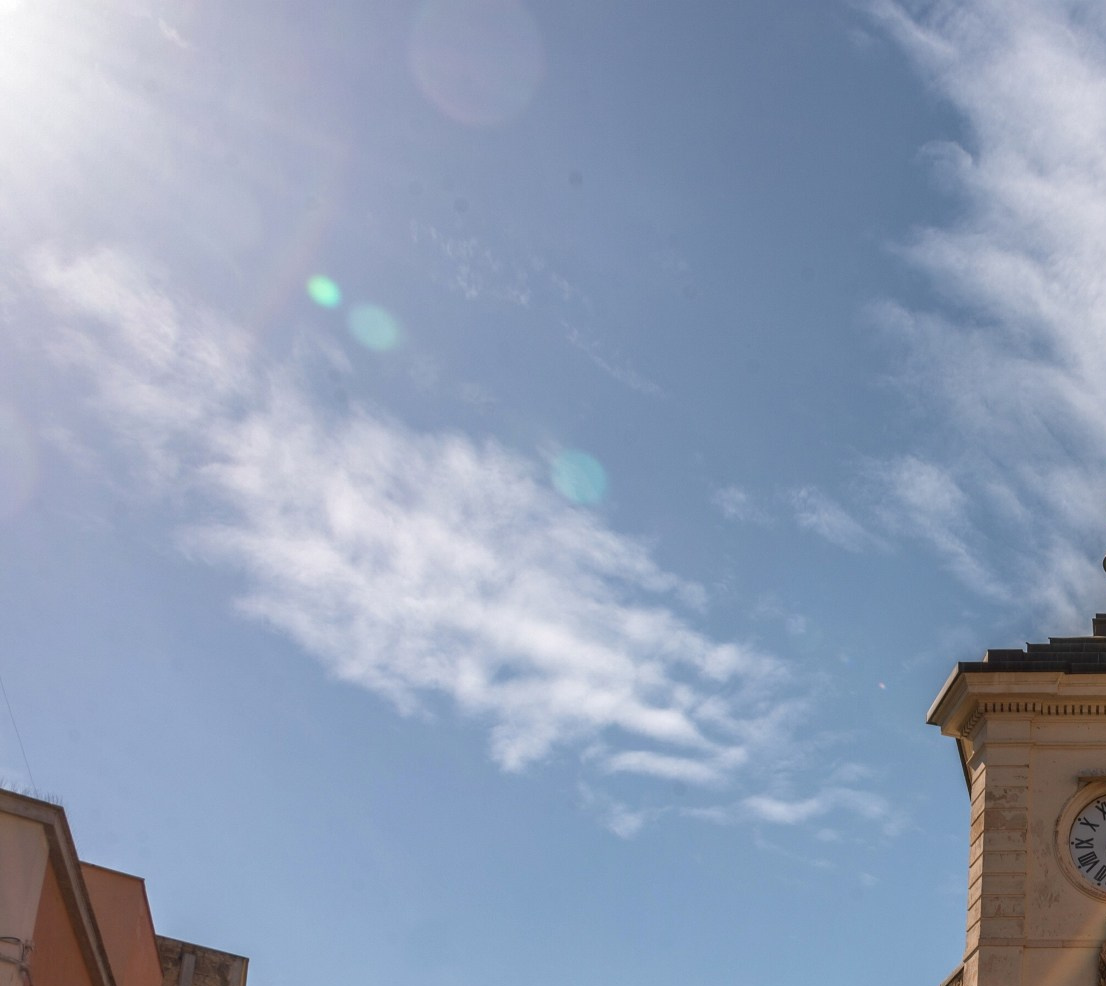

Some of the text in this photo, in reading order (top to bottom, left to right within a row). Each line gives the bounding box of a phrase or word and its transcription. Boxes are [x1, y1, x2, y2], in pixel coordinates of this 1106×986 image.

[1079, 816, 1100, 832] X
[1075, 837, 1094, 849] IX
[1078, 851, 1100, 874] VIII
